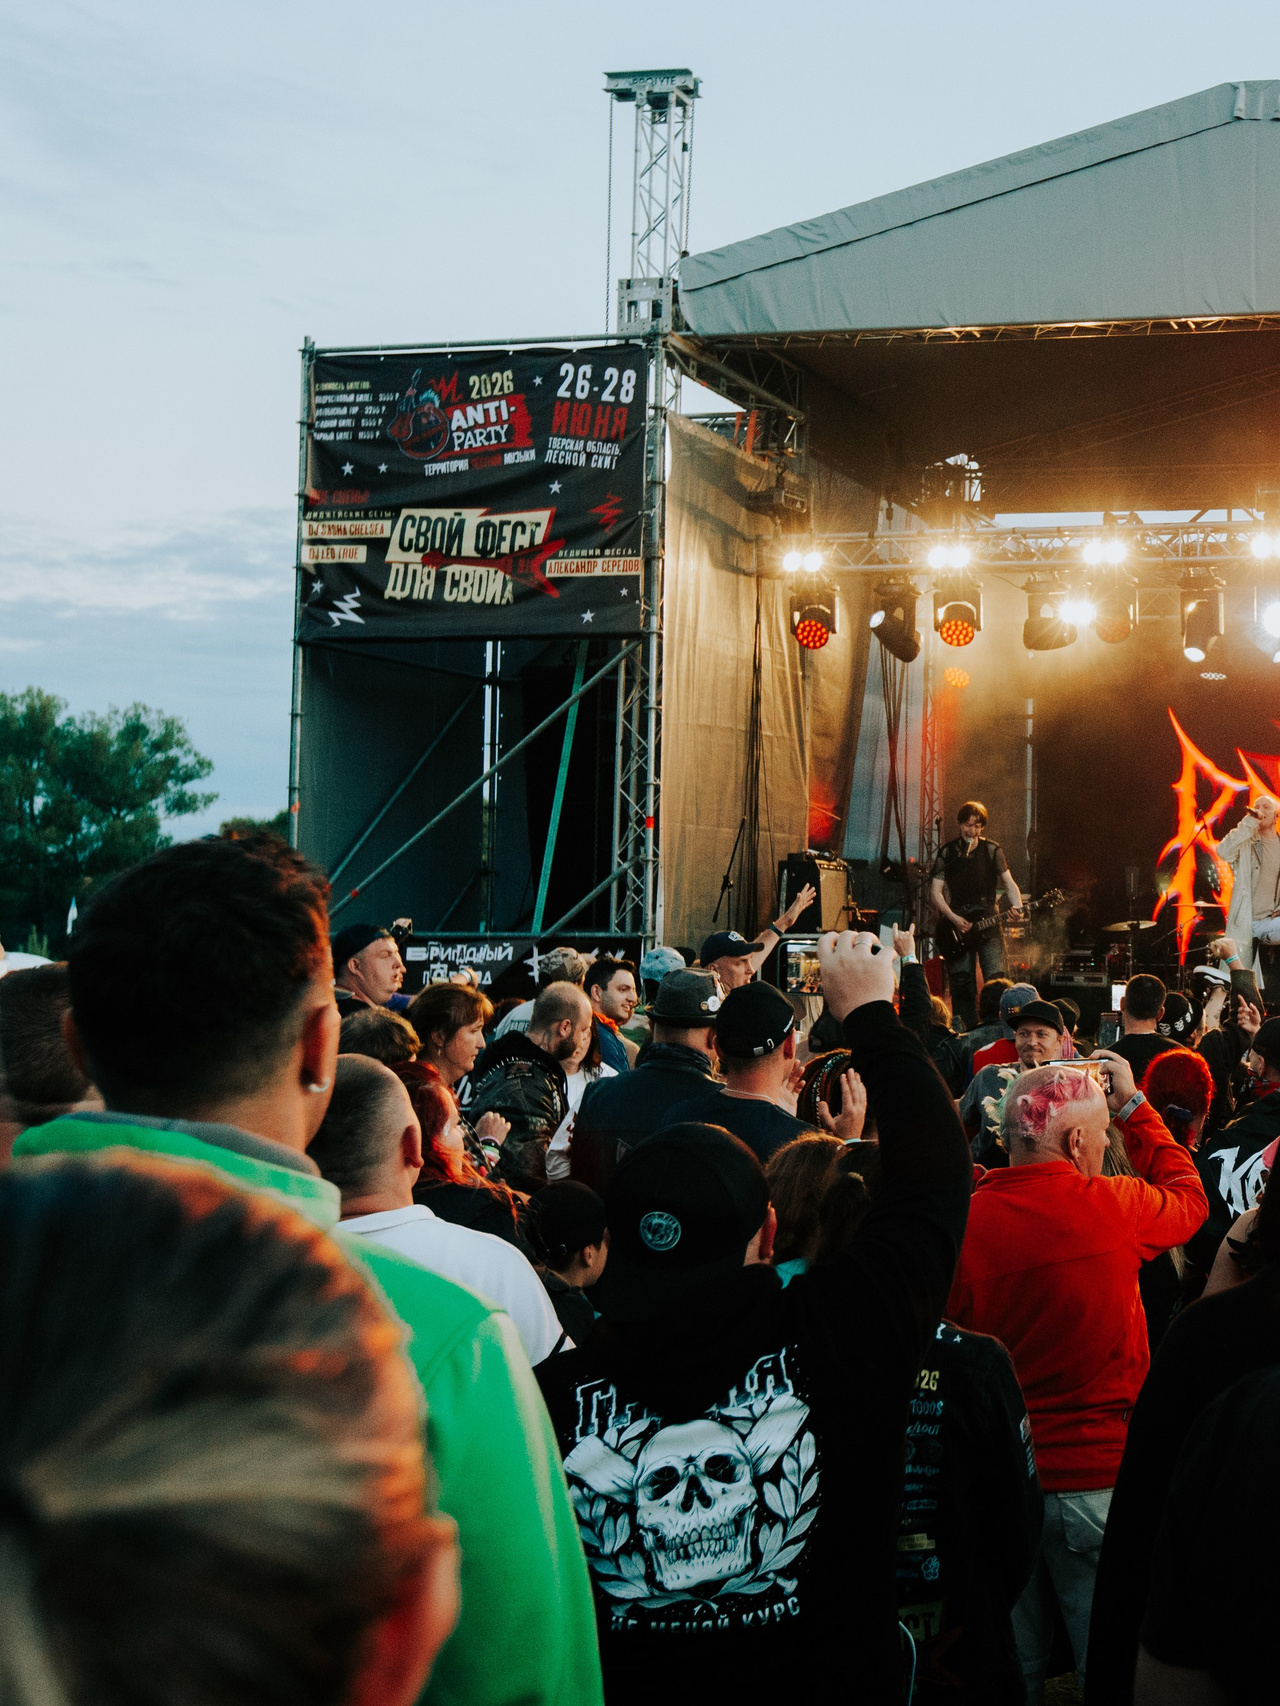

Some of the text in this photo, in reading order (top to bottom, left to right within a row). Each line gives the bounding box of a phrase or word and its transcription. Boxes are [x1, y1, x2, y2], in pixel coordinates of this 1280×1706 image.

[469, 369, 514, 399] 2026
[556, 362, 637, 404] 26-28
[451, 399, 517, 431] ANTI-
[552, 400, 628, 440] ИЮНЯ
[452, 424, 508, 451] PARTY
[548, 436, 585, 452] ТВЕРСКАЯ
[424, 459, 469, 476] ТЕРРИТОРИЯ
[504, 449, 536, 465] МУЗЫКИ
[544, 449, 618, 470] ЛЕСНОЙ СКИТ
[308, 524, 320, 536] DJ
[349, 522, 385, 535] CHELSEA
[398, 512, 541, 558] СВОЙ ФЕСТ
[309, 547, 320, 560] DJ
[548, 560, 598, 574] АЛЕКСАНДР
[384, 564, 514, 605] ДЛЯ СВОИХ
[914, 1369, 940, 1392] 26
[742, 1596, 799, 1629] КУРС
